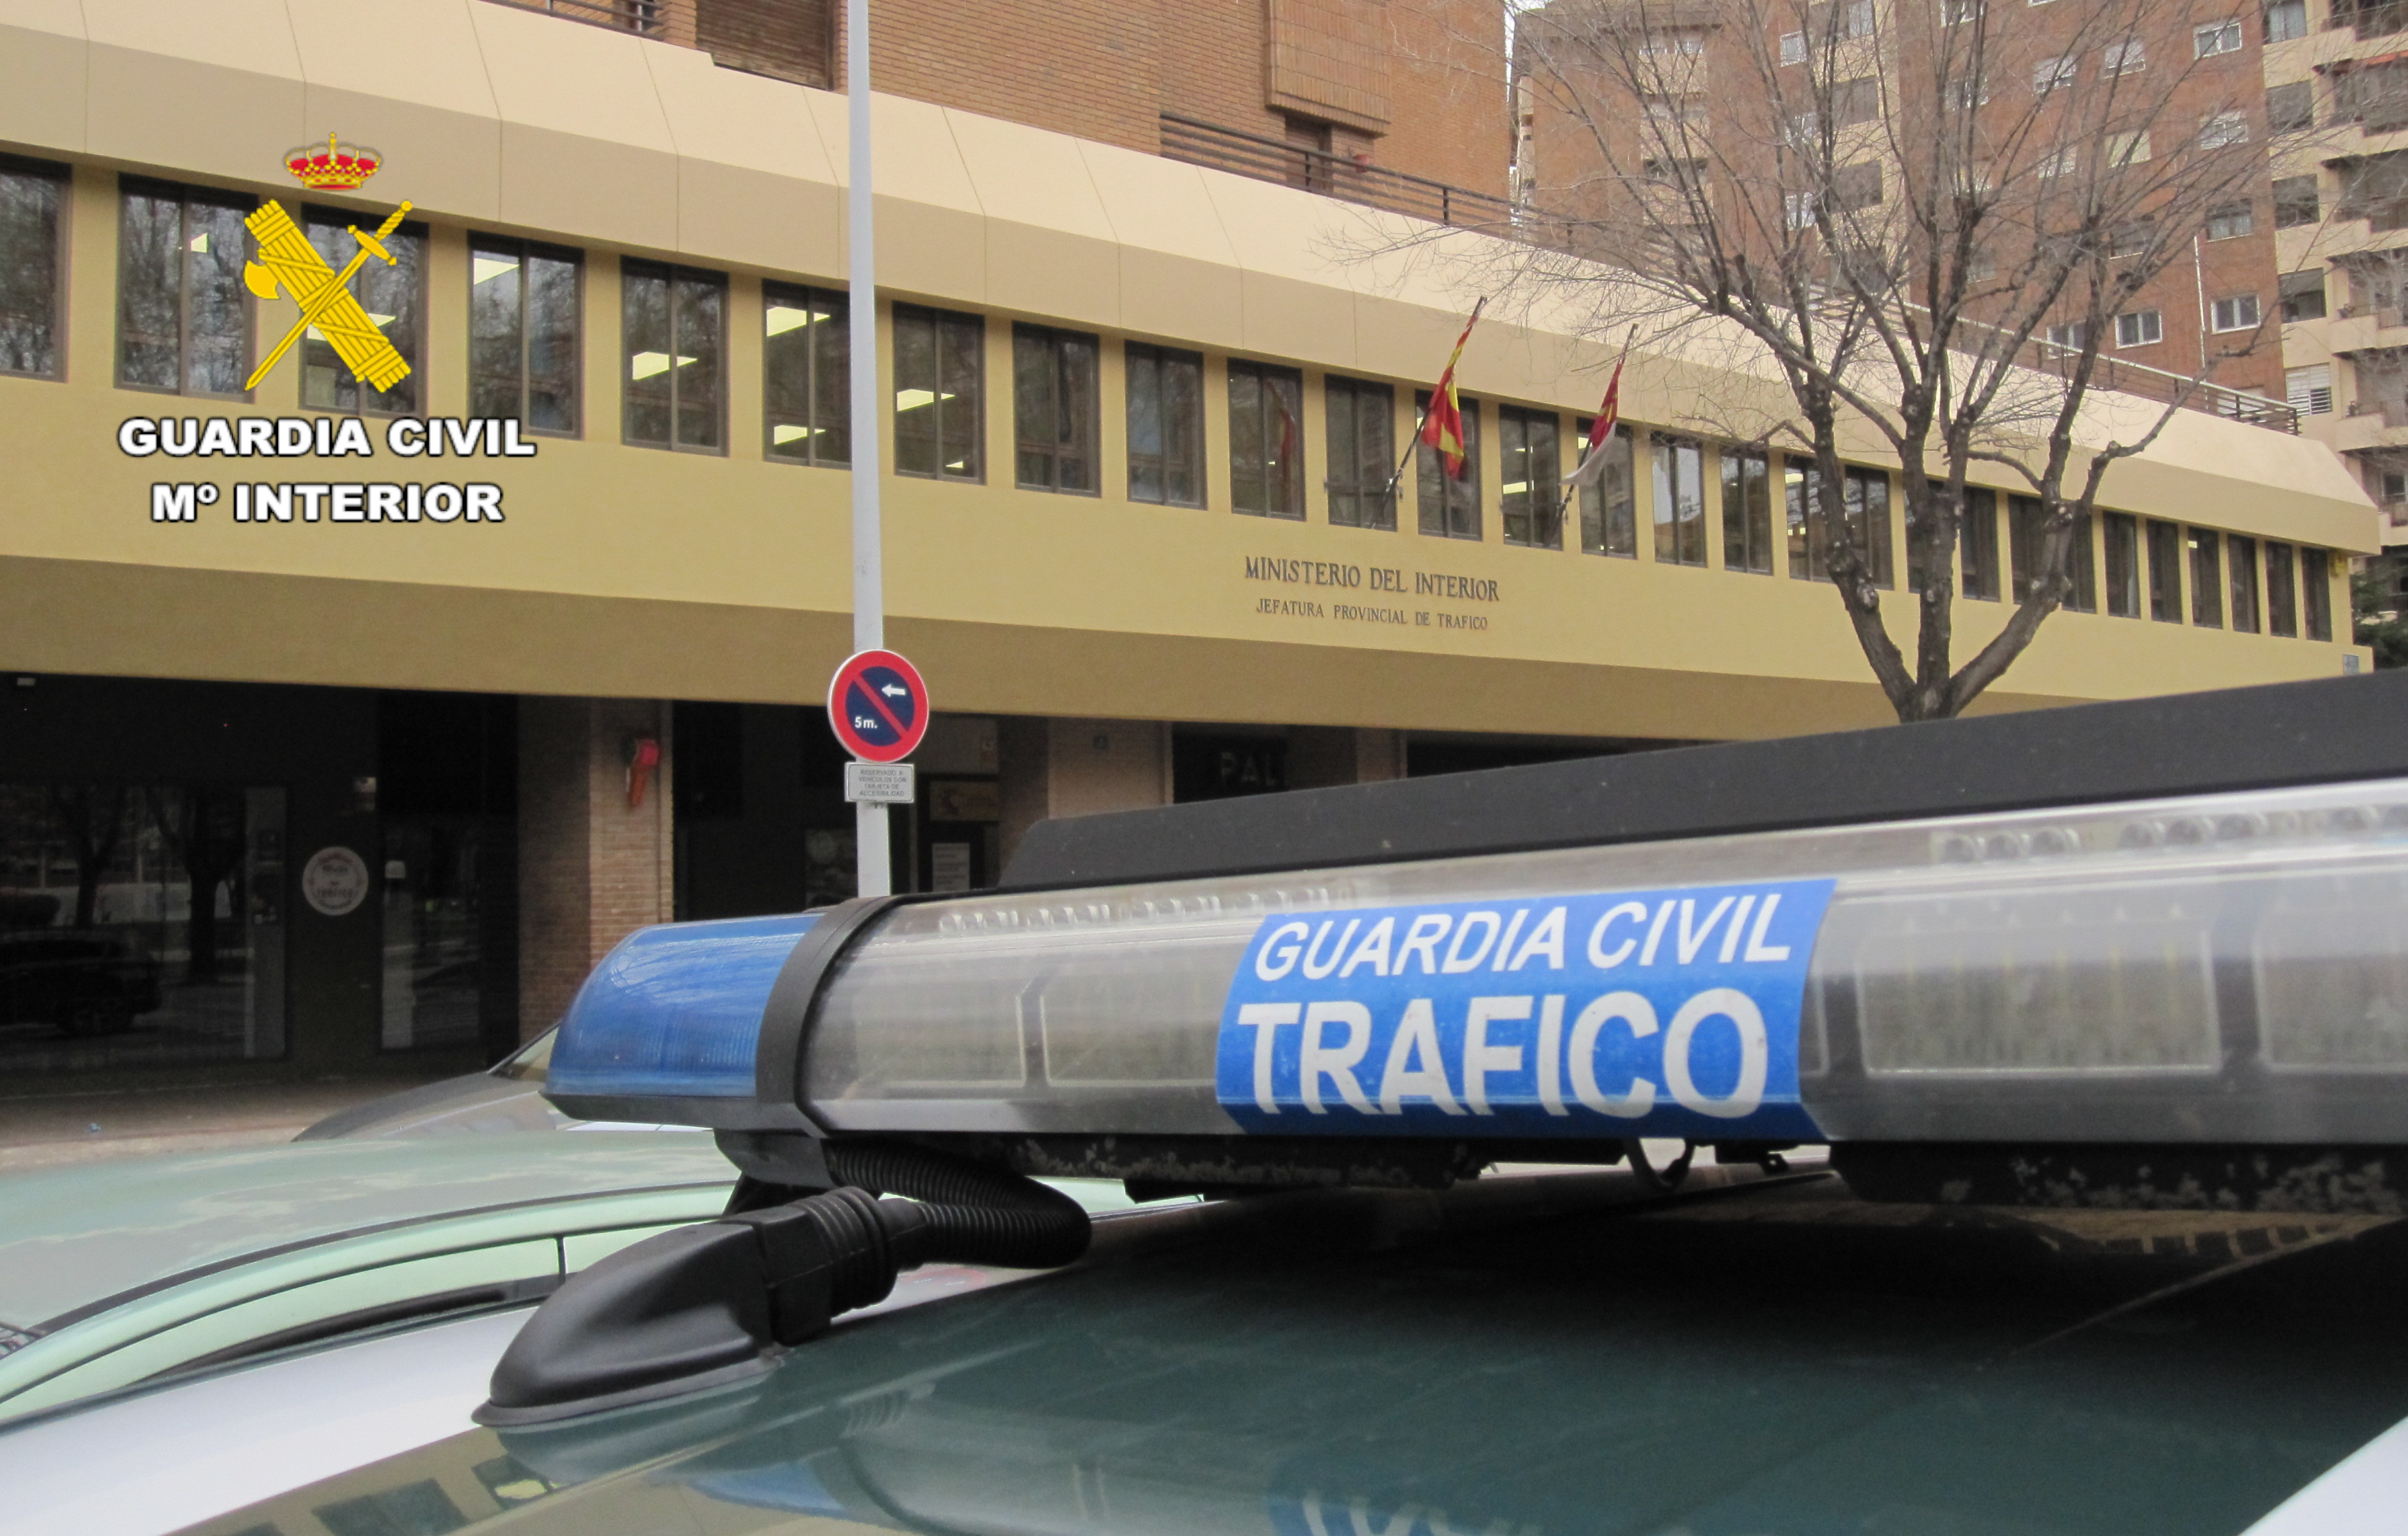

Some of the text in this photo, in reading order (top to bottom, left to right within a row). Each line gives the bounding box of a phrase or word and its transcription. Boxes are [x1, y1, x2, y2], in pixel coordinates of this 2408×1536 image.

[1244, 556, 1499, 601] MINISTERIO DEL INTERIOR
[1256, 598, 1488, 630] JEFATURA PROVINCIAL DE TRAFICO
[1255, 893, 1791, 982] GUARDIA CIVIL
[1237, 987, 1768, 1119] TRAFICO
